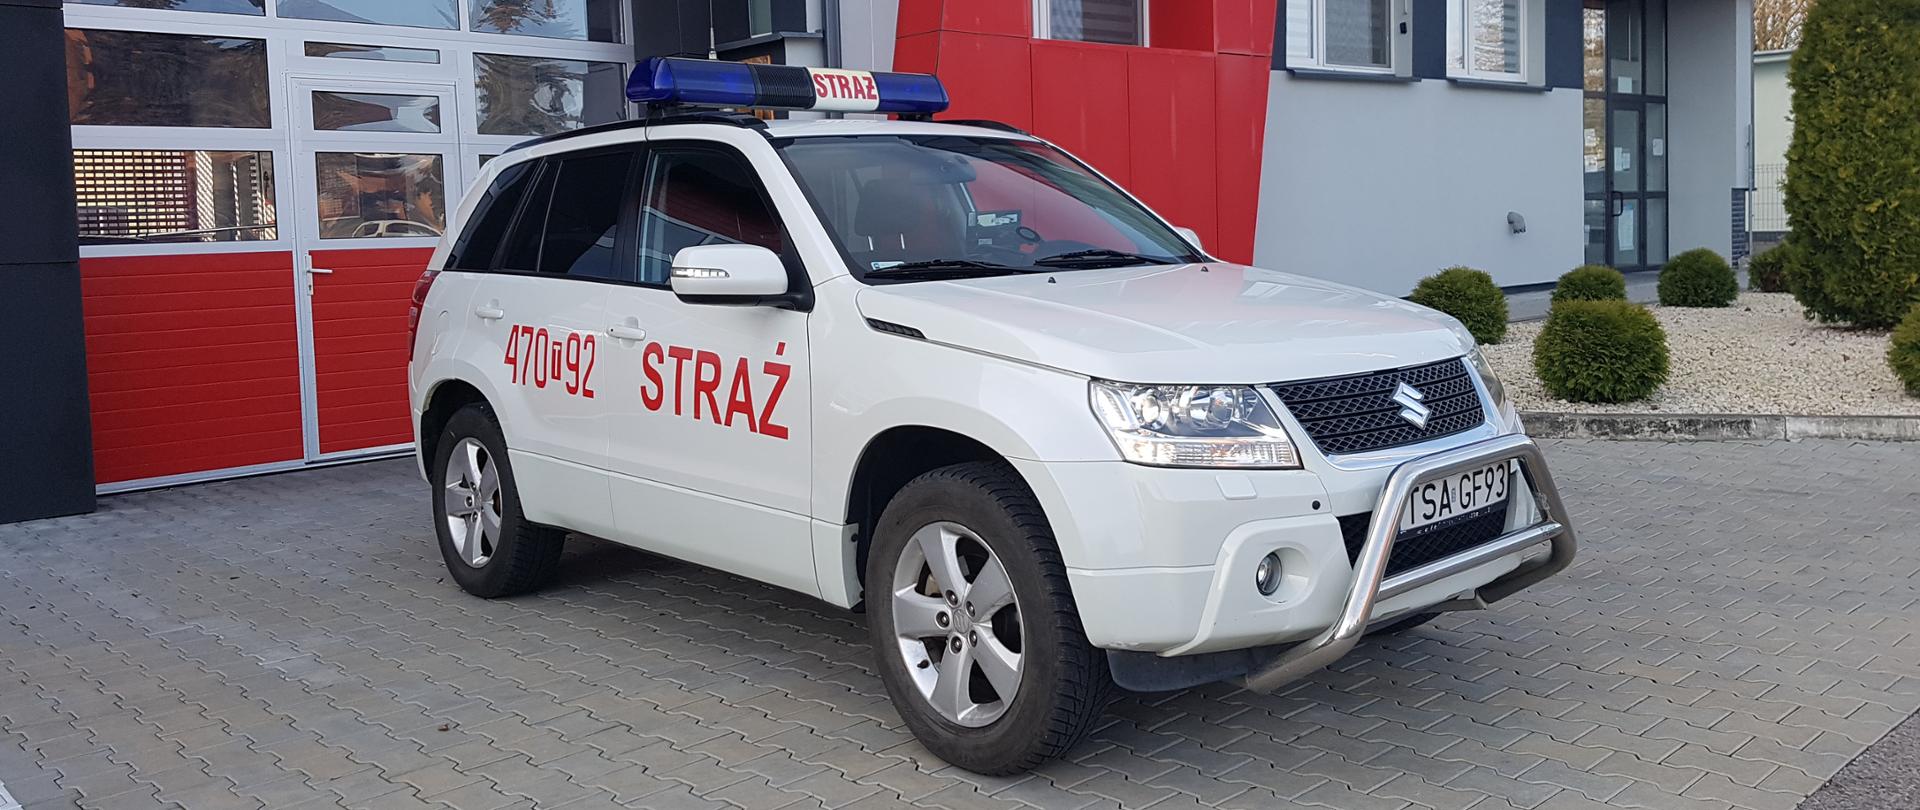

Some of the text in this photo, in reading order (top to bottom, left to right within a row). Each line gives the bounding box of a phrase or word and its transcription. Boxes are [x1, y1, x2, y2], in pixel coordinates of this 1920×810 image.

[640, 341, 791, 440] STRAŻ
[1410, 479, 1452, 525] TSA
[1459, 463, 1505, 510] GF93
